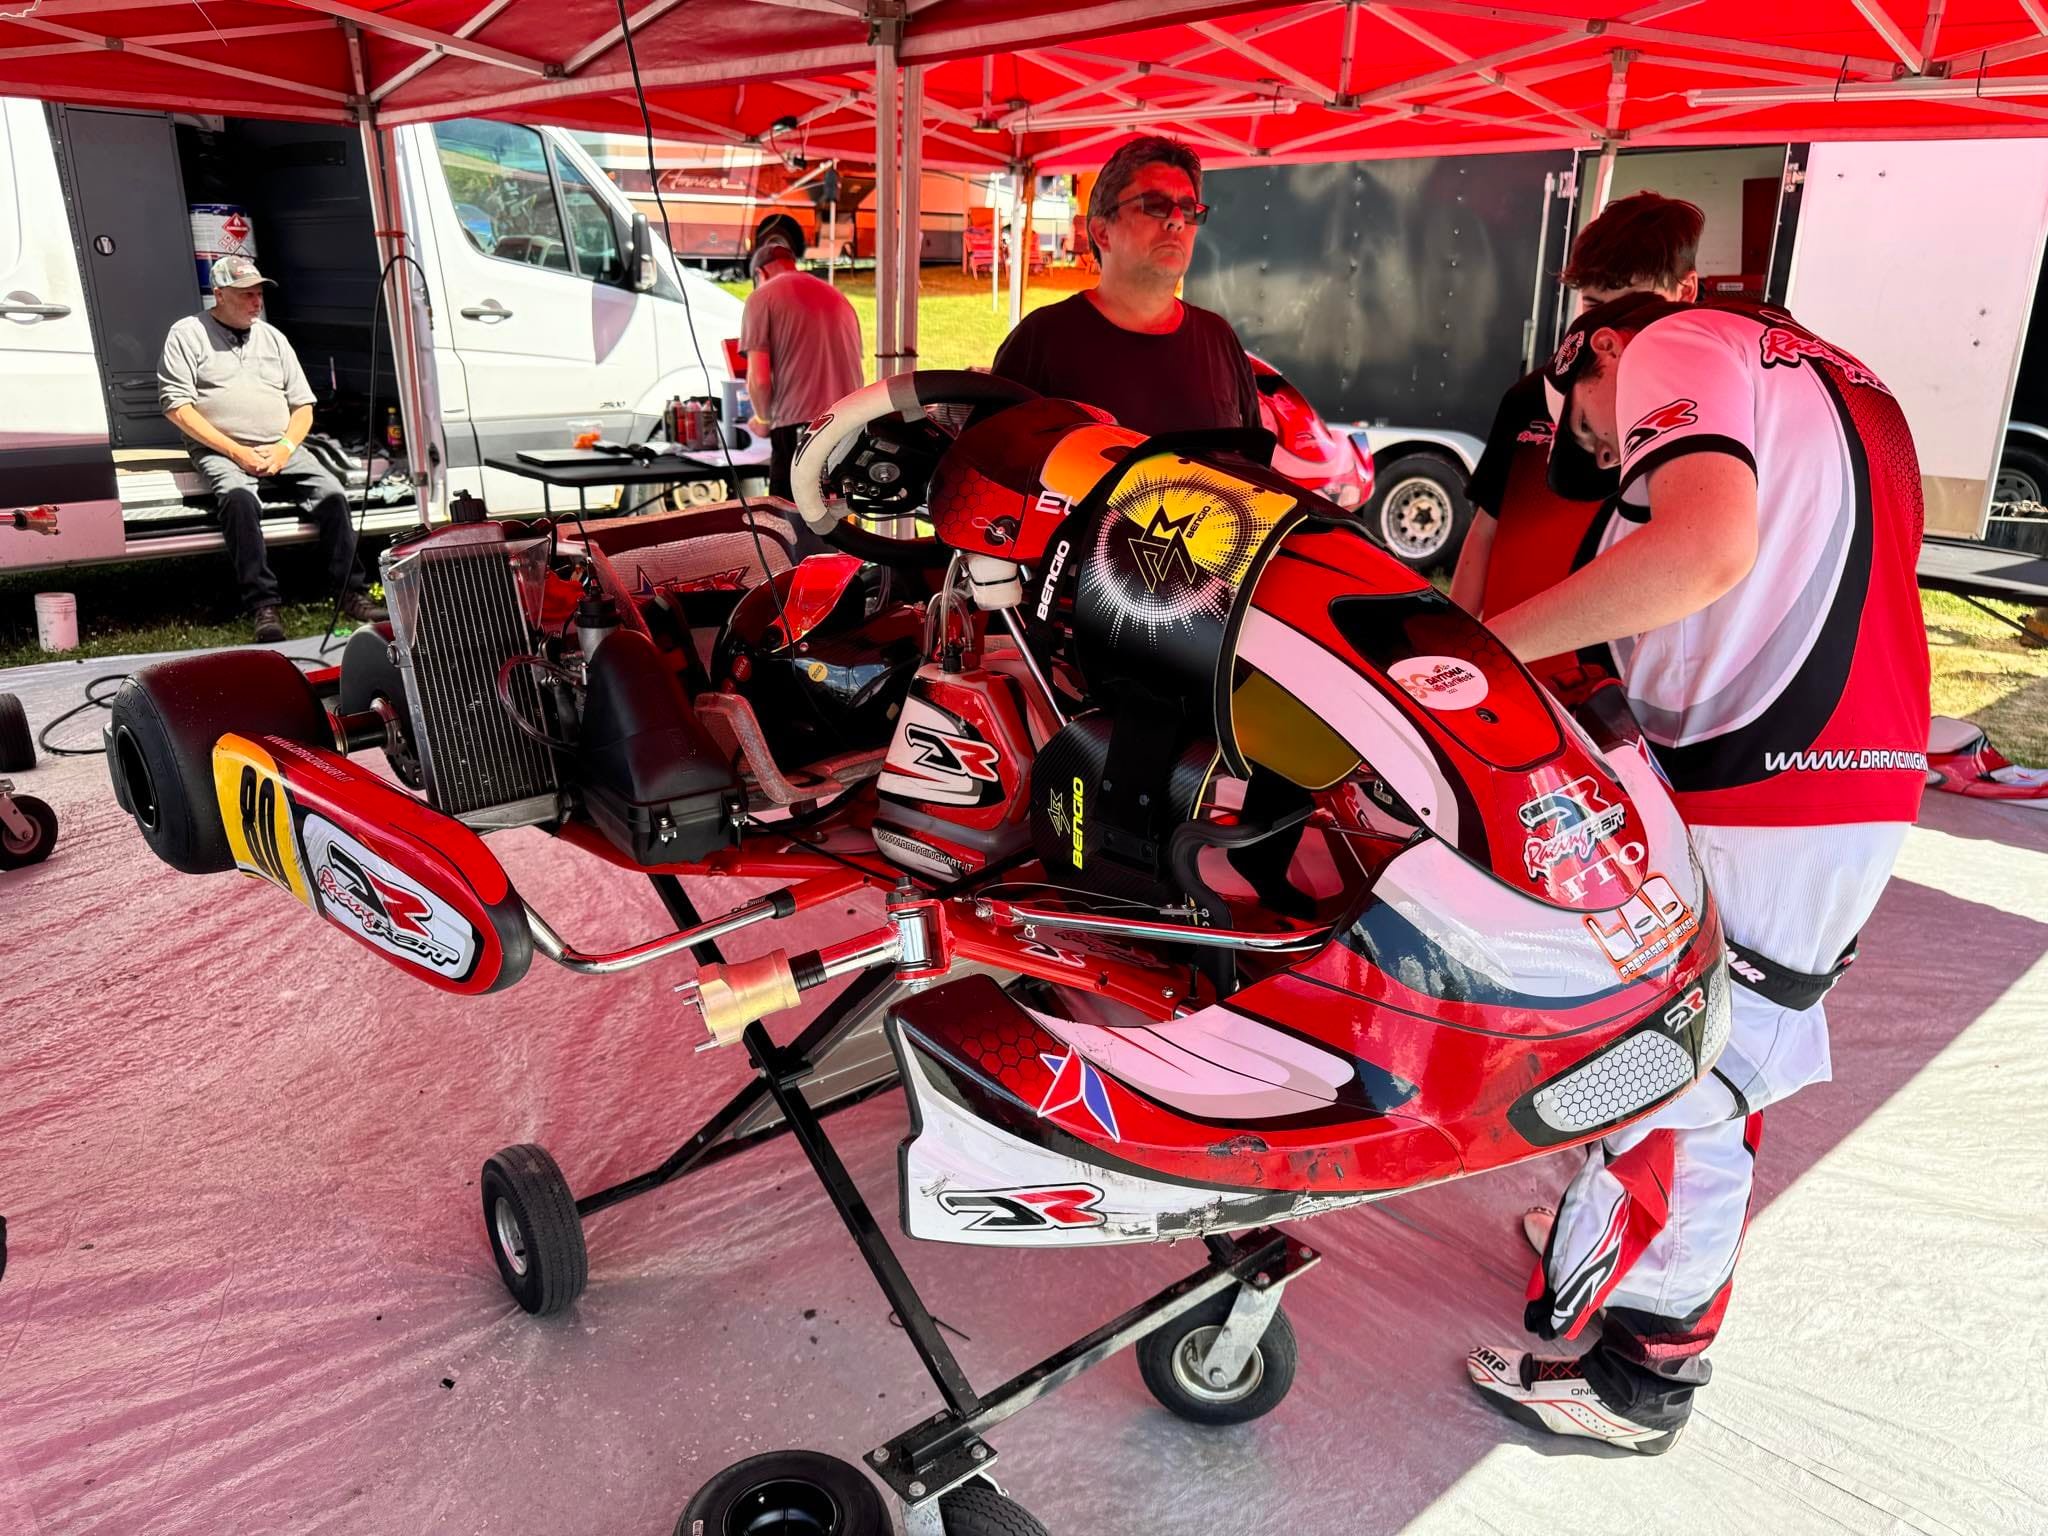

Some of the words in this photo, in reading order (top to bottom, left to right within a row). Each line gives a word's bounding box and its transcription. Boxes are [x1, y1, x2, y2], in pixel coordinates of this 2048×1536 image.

[1036, 540, 1071, 622] BENGIO
[1072, 776, 1084, 871] BENGIO
[1560, 841, 1645, 903] ITO
[1618, 935, 1669, 979] PREPARED
